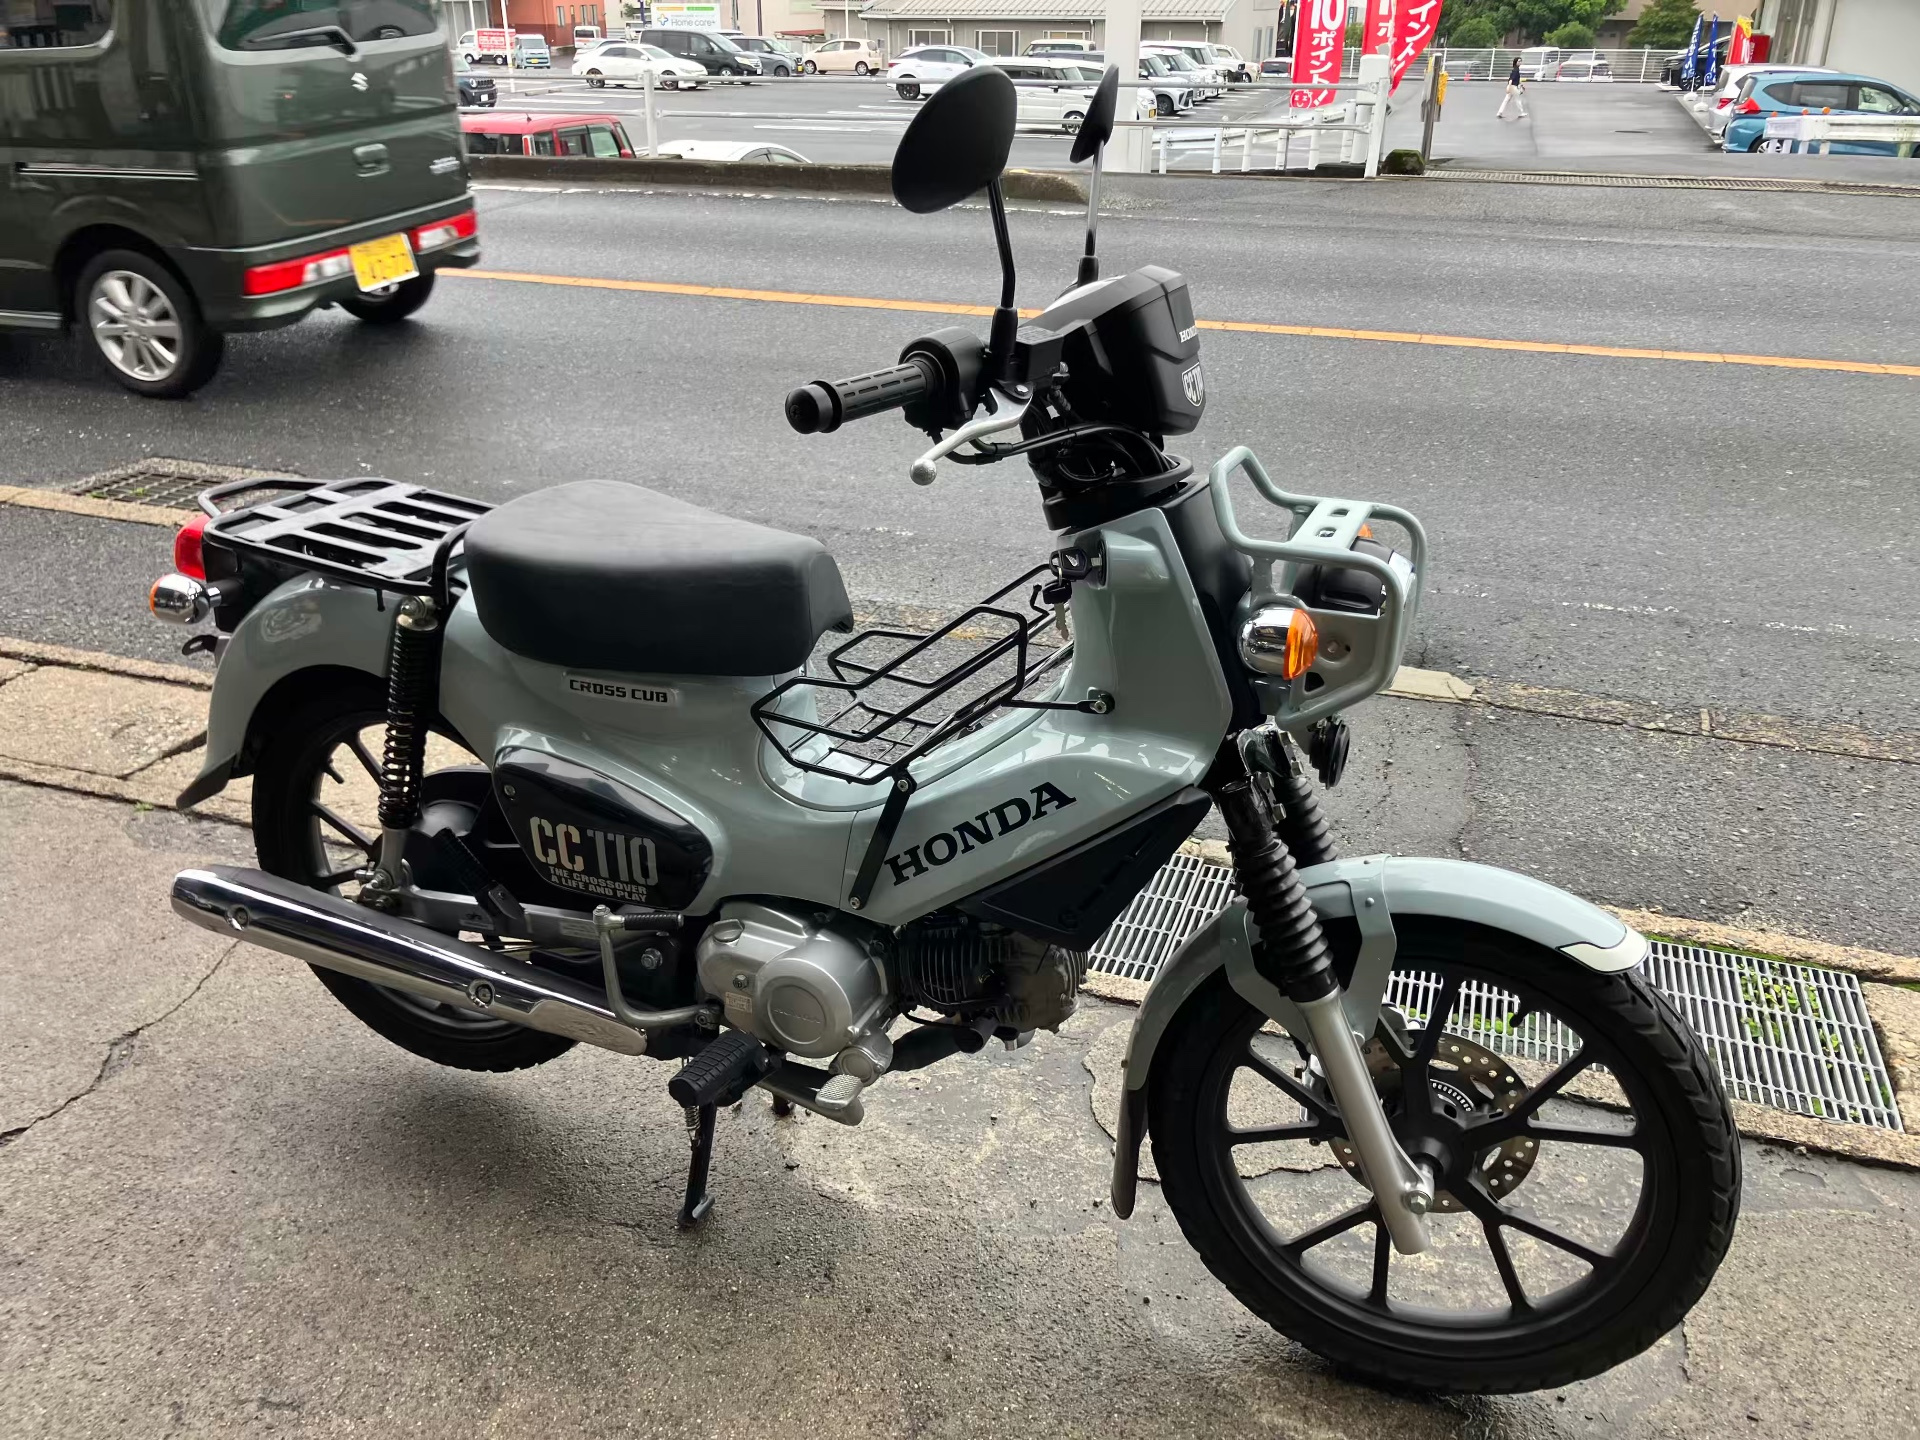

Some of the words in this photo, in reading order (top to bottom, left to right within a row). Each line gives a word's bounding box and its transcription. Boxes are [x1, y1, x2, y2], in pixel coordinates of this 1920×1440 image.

[671, 18, 693, 26] Home
[569, 679, 627, 698] CROSS
[631, 688, 668, 703] CUB
[883, 781, 1077, 886] HONDA
[548, 866, 570, 879] THE
[573, 872, 647, 895] CROSSOVER
[551, 874, 560, 884] A
[562, 877, 586, 890] LIFE
[588, 884, 614, 896] AND
[616, 890, 647, 902] PLAY
